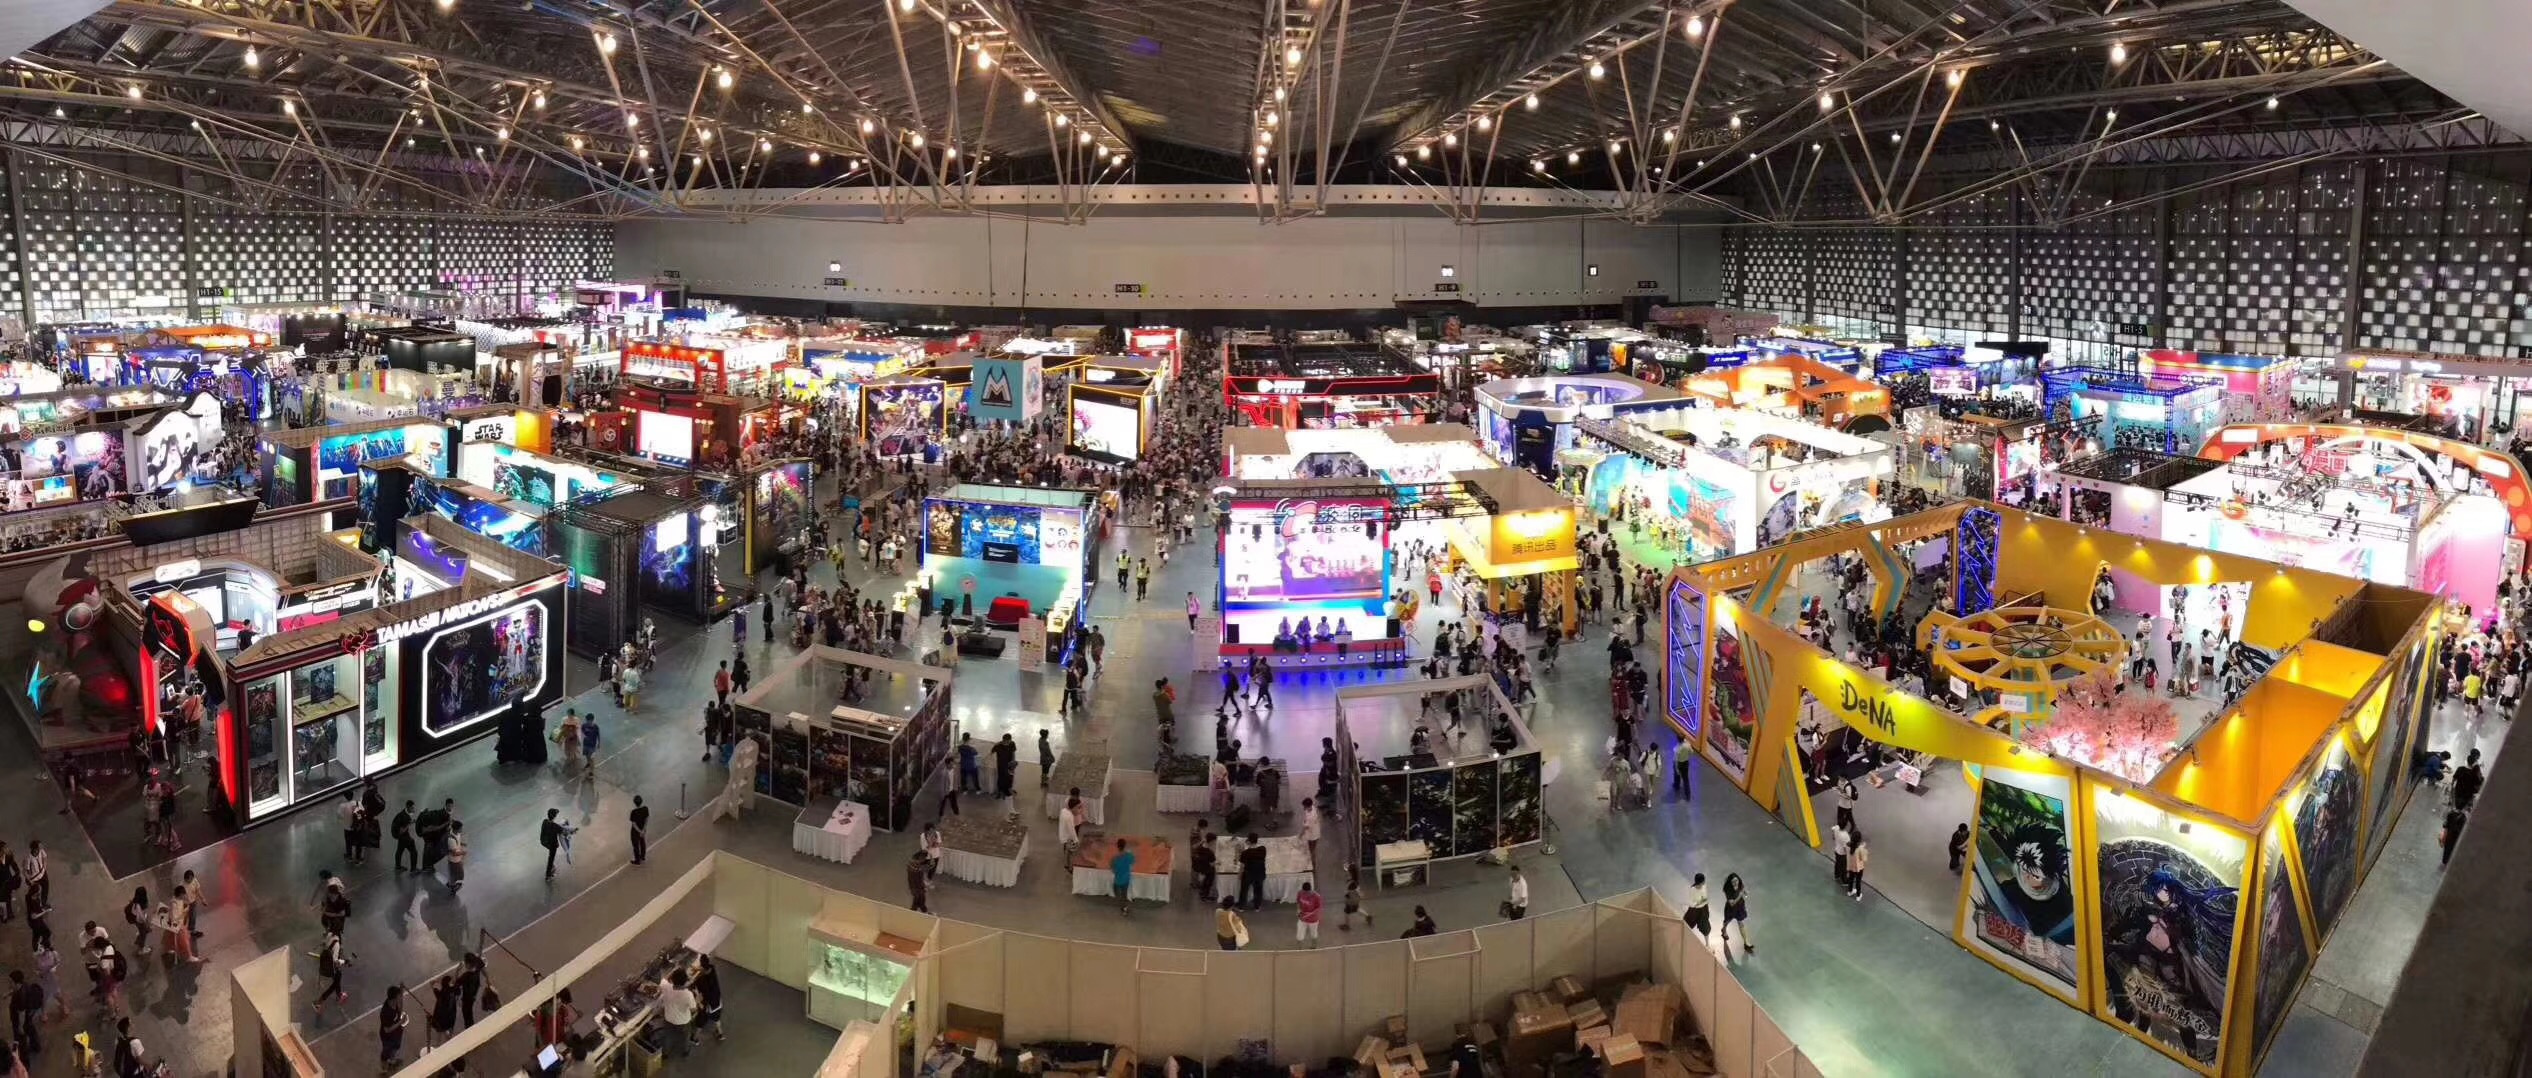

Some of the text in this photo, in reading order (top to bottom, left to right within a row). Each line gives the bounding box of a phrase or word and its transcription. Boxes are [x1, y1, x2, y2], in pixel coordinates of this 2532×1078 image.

[475, 423, 503, 435] STAR
[475, 431, 503, 440] WARS
[376, 611, 441, 643] TAMASHII
[441, 593, 500, 625] NATIONS
